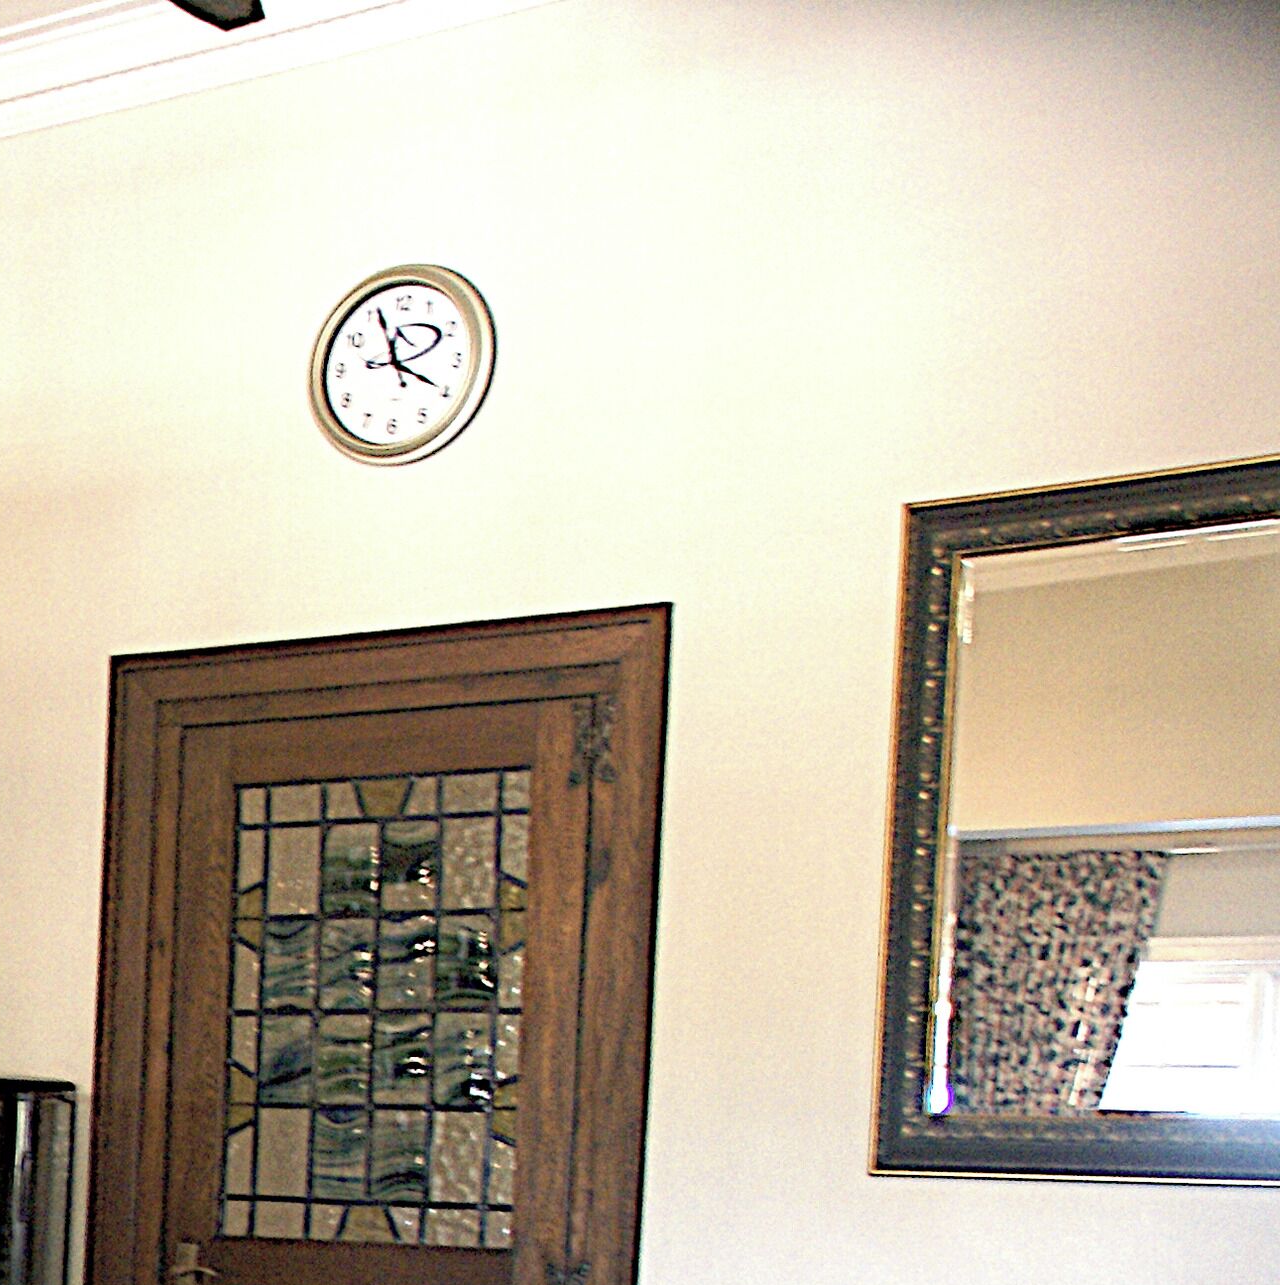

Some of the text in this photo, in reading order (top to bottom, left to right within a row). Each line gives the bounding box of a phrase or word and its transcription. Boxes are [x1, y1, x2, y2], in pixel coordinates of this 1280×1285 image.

[395, 294, 414, 311] 12
[425, 300, 434, 315] 1
[444, 320, 457, 337] 2
[346, 331, 364, 348] 10
[451, 351, 462, 369] 3
[335, 362, 346, 379] 9
[341, 392, 352, 408] 8
[362, 412, 373, 428] 7
[417, 407, 428, 424] 5
[386, 418, 398, 435] 6
